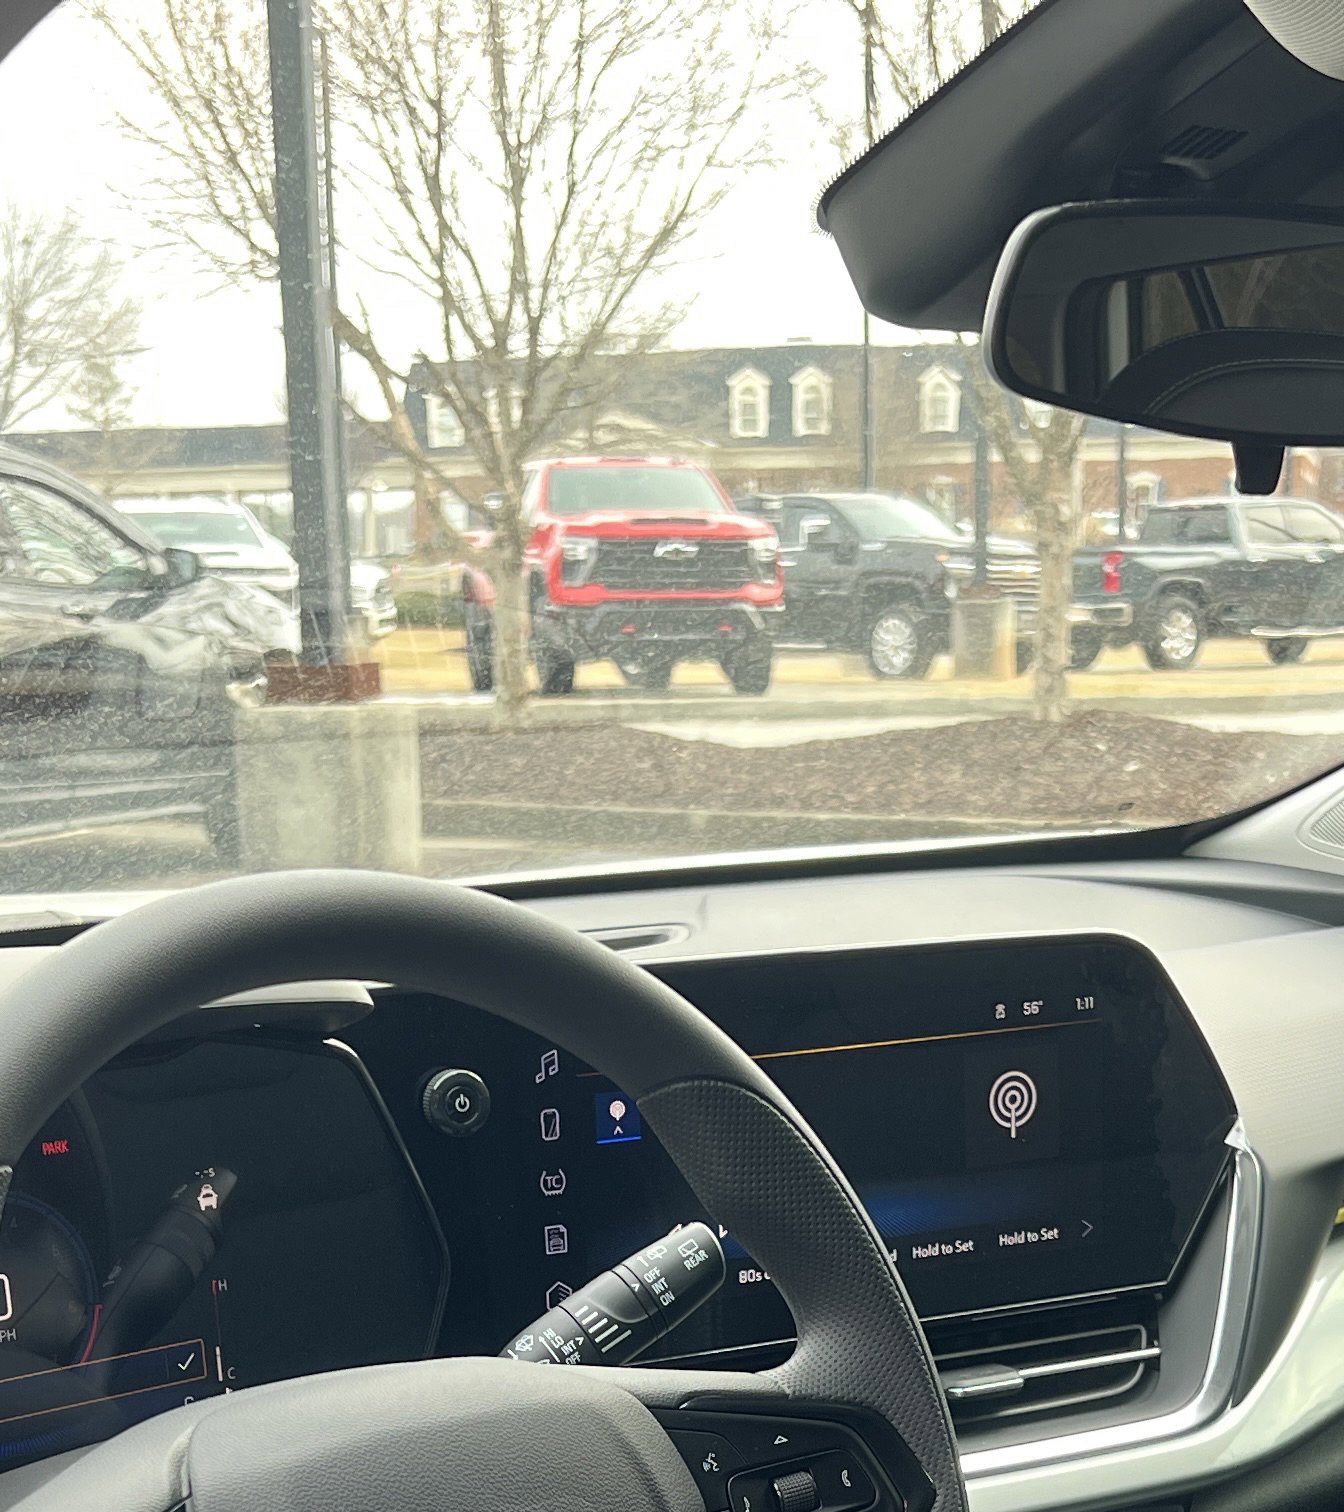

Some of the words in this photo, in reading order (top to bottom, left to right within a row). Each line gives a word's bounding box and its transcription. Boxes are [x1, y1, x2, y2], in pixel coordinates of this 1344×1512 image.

[1076, 996, 1094, 1011] 1:11
[41, 1139, 70, 1157] PARK
[998, 1231, 1025, 1247] Hold
[1027, 1232, 1039, 1243] to
[1041, 1227, 1059, 1241] Set
[912, 1242, 939, 1259] Hold
[941, 1243, 953, 1255] to
[955, 1239, 974, 1253] Set
[683, 1249, 709, 1271] REAR
[643, 1267, 661, 1283] OFF
[738, 1268, 763, 1284] 80s
[652, 1278, 669, 1296] INT
[660, 1292, 675, 1307] ON
[551, 1335, 564, 1350] LO
[560, 1340, 577, 1357] INT
[565, 1353, 582, 1365] OFF
